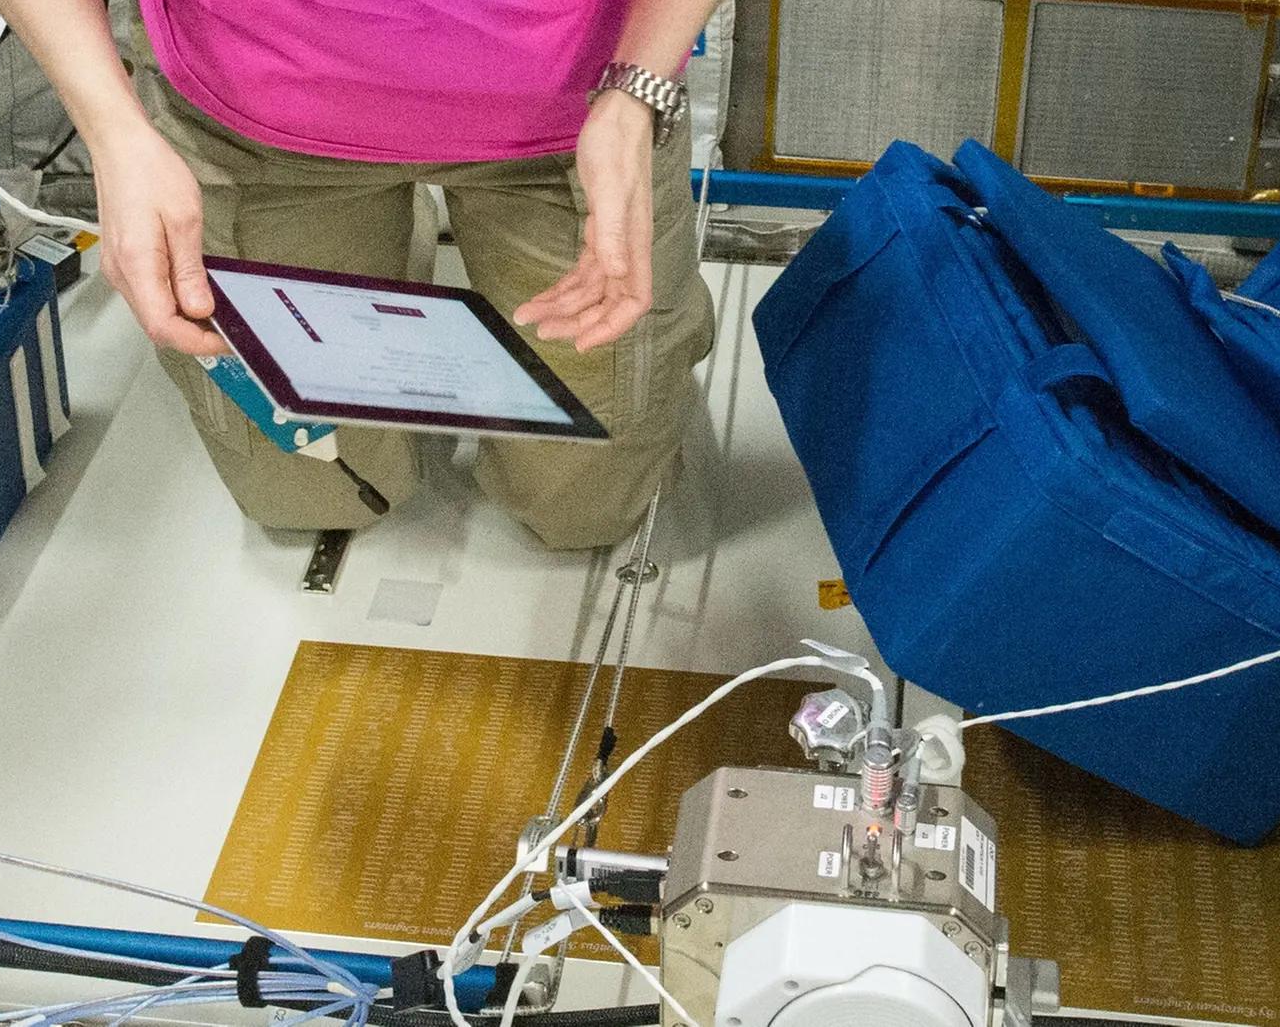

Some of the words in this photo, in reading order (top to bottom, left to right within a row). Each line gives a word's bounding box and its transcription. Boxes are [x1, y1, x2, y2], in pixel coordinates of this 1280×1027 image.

[827, 705, 844, 721] KNOB
[839, 788, 849, 810] POWER
[941, 826, 951, 849] POWER
[825, 853, 835, 876] POWER
[364, 920, 419, 936] Engineers
[1195, 1000, 1255, 1018] European
